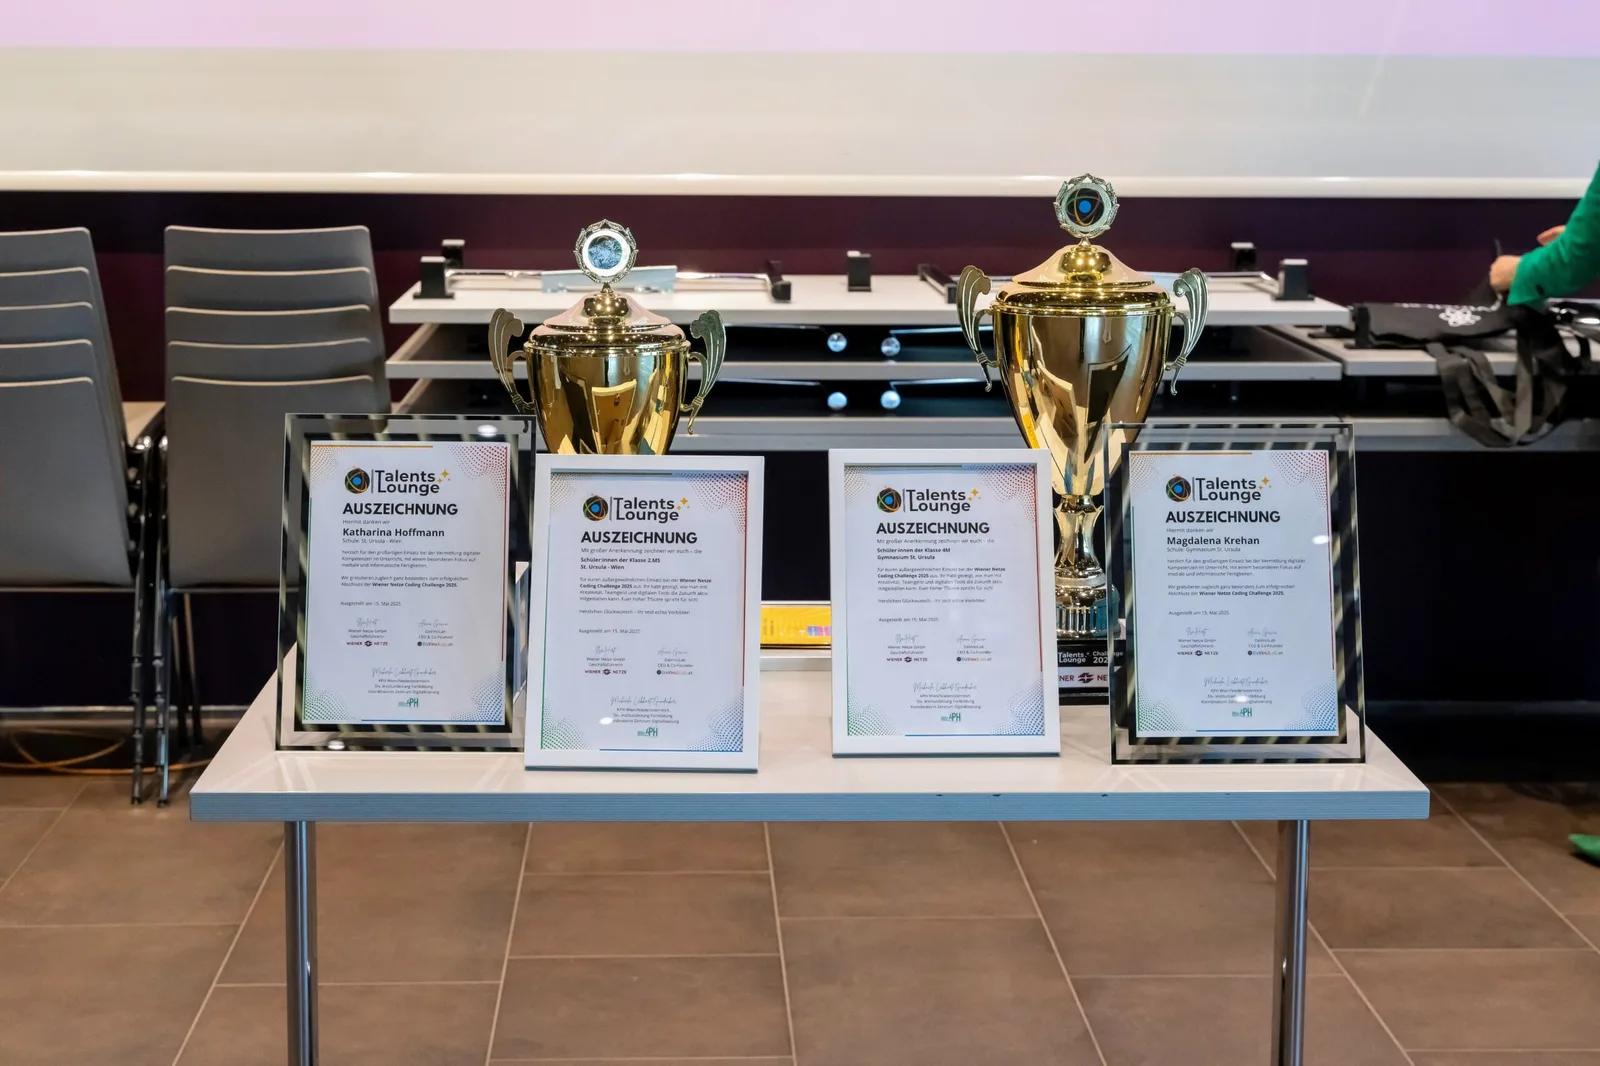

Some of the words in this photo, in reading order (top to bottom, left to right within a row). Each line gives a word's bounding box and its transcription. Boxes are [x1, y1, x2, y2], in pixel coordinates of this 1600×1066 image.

[375, 470, 435, 482] Talents
[1196, 478, 1256, 489] Talents
[378, 484, 439, 496] Lounge
[906, 489, 965, 500] Talents
[614, 497, 674, 509] Talents
[1200, 491, 1261, 503] Lounge
[343, 503, 458, 515] AUSZEICHNUNG
[910, 502, 970, 514] Lounge
[616, 511, 679, 523] Lounge
[1166, 511, 1280, 522] AUSZEICHNUNG
[343, 528, 392, 536] Katharina
[395, 528, 444, 537] Hoffmann
[876, 523, 989, 534] AUSZEICHNUNG
[581, 532, 697, 544] AUSZEICHNUNG
[1167, 536, 1221, 547] Magdalena
[1224, 536, 1260, 544] Krehan
